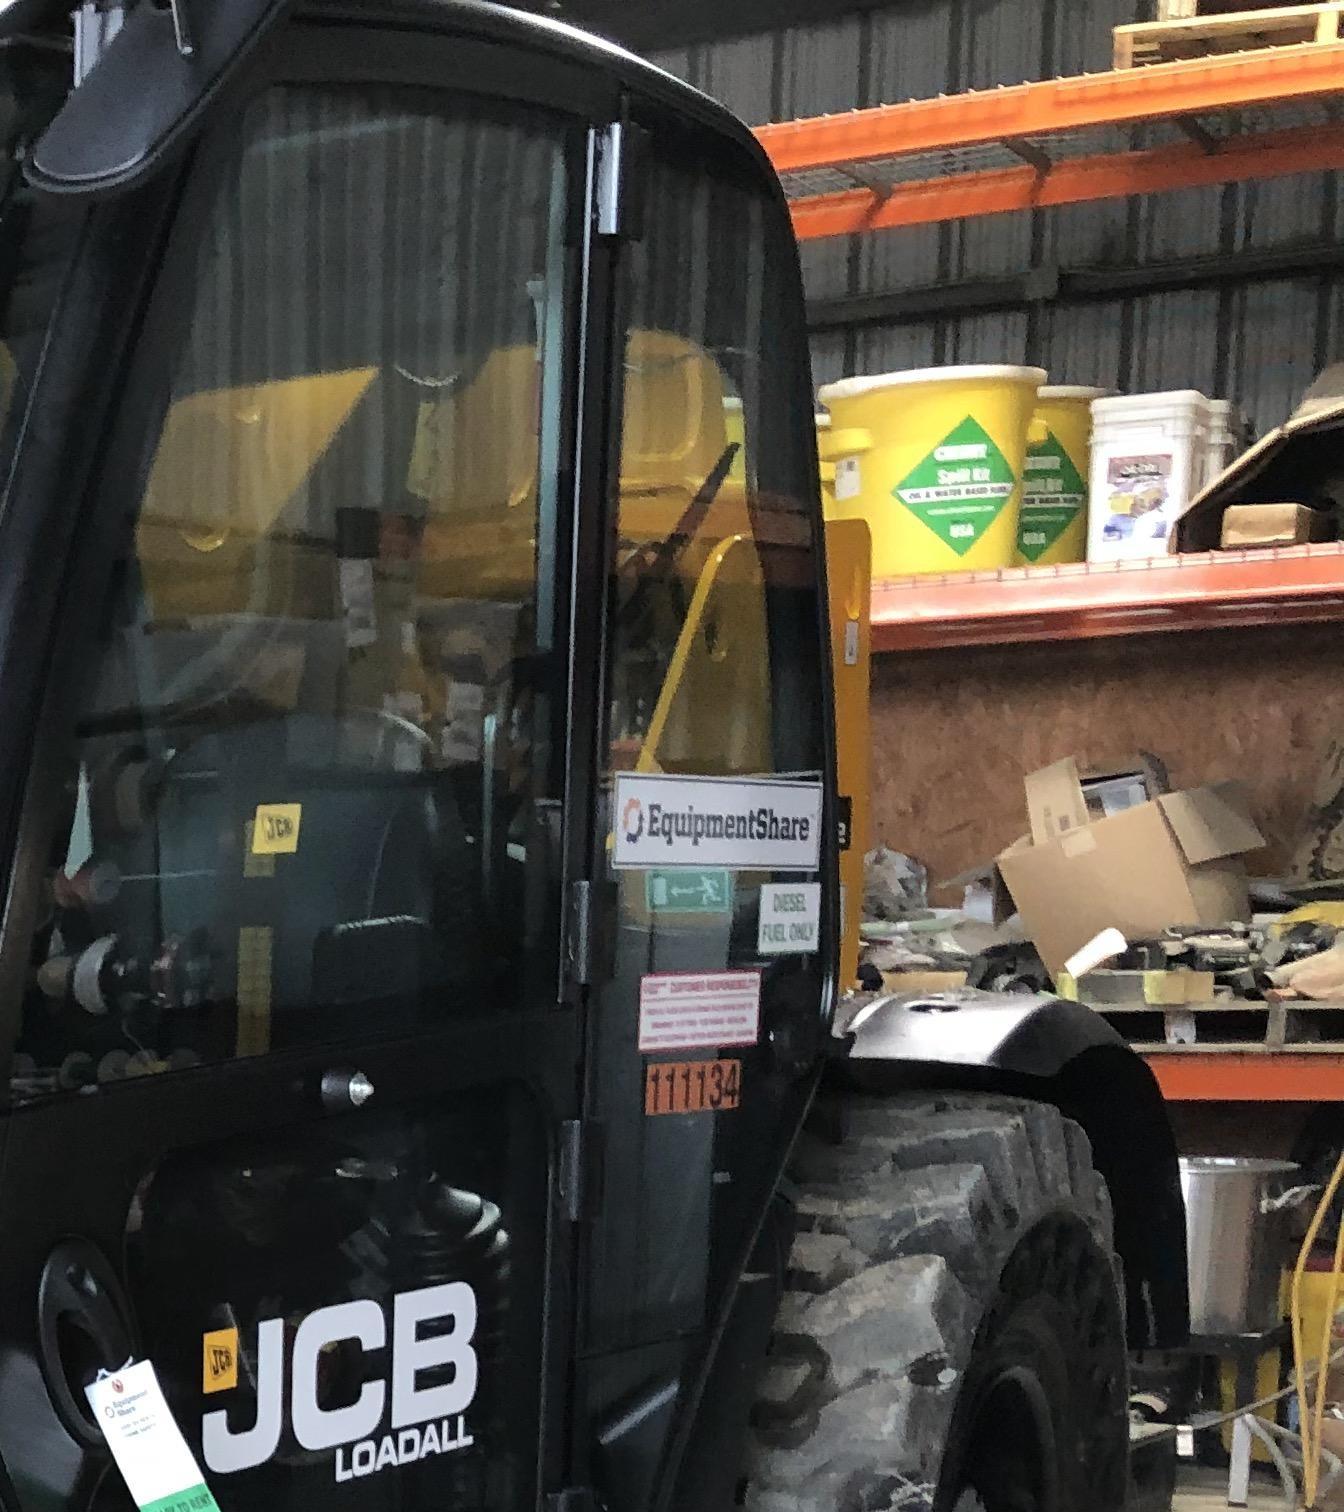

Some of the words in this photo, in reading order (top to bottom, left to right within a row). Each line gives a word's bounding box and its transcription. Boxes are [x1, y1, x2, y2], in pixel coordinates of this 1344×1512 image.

[267, 816, 294, 841] JCB
[648, 804, 811, 847] EquipmentShare
[774, 893, 807, 912] DIESEL
[762, 923, 787, 942] FUEL
[789, 922, 815, 942] ONLY
[650, 1063, 737, 1112] 111134
[212, 1349, 233, 1376] JCB
[202, 1281, 479, 1474] JCB
[334, 1416, 474, 1484] LOADALL
[190, 1493, 213, 1510] RENT
